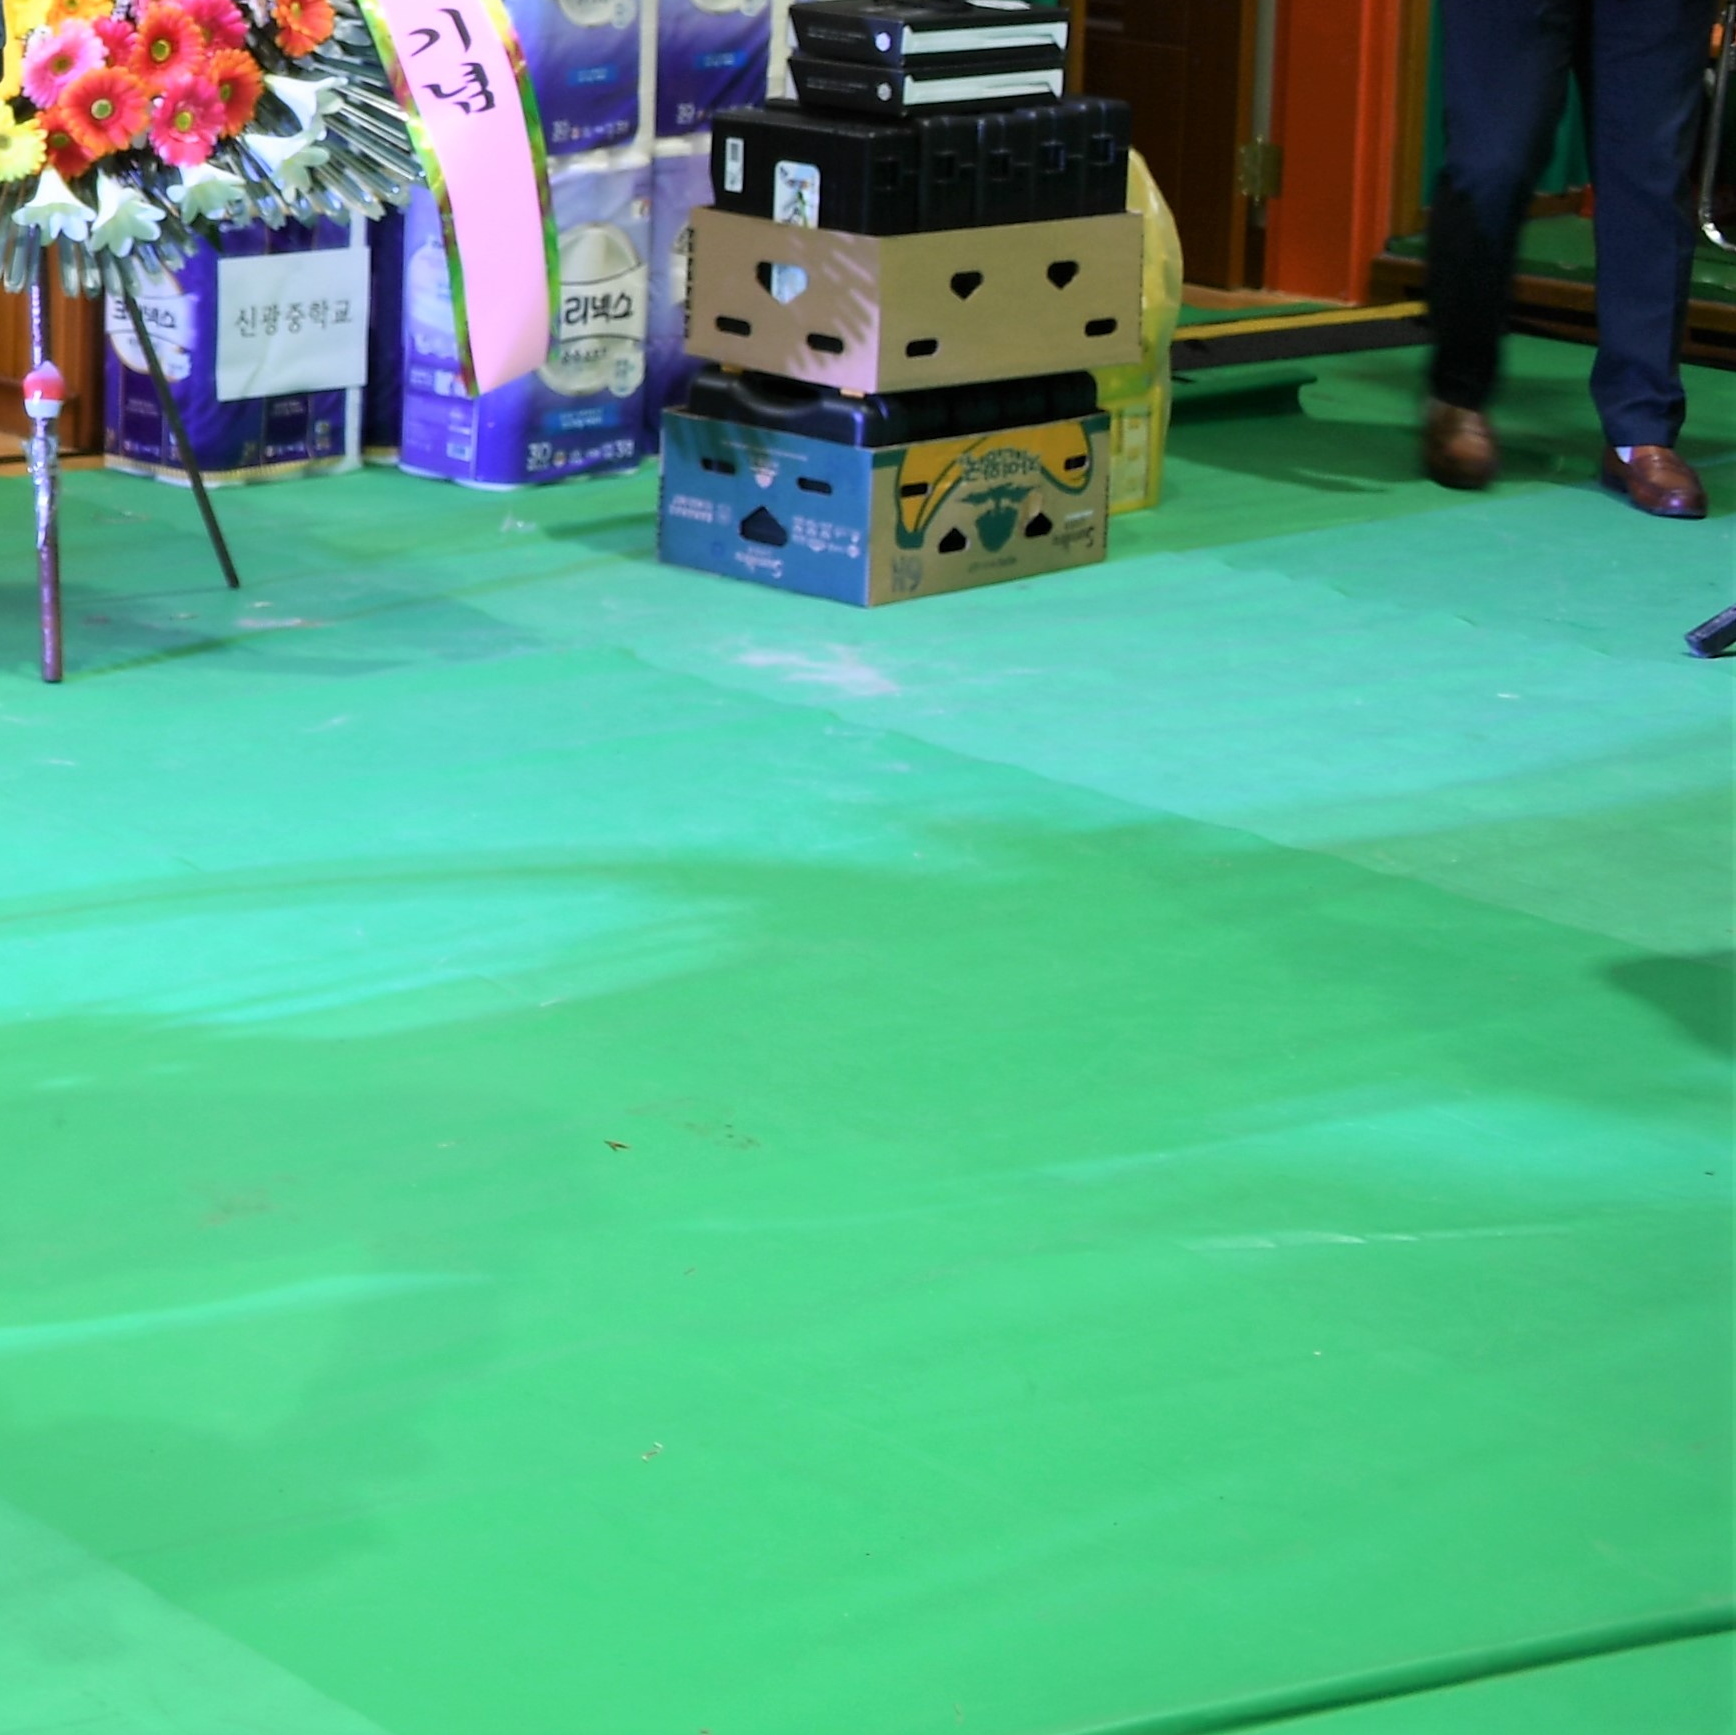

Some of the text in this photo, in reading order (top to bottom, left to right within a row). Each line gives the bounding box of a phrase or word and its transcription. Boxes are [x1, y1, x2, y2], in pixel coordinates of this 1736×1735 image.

[408, 7, 498, 117] 기념
[112, 298, 179, 331] 크넥스
[233, 298, 352, 339] 신광중학교
[563, 292, 635, 325] 리넥스
